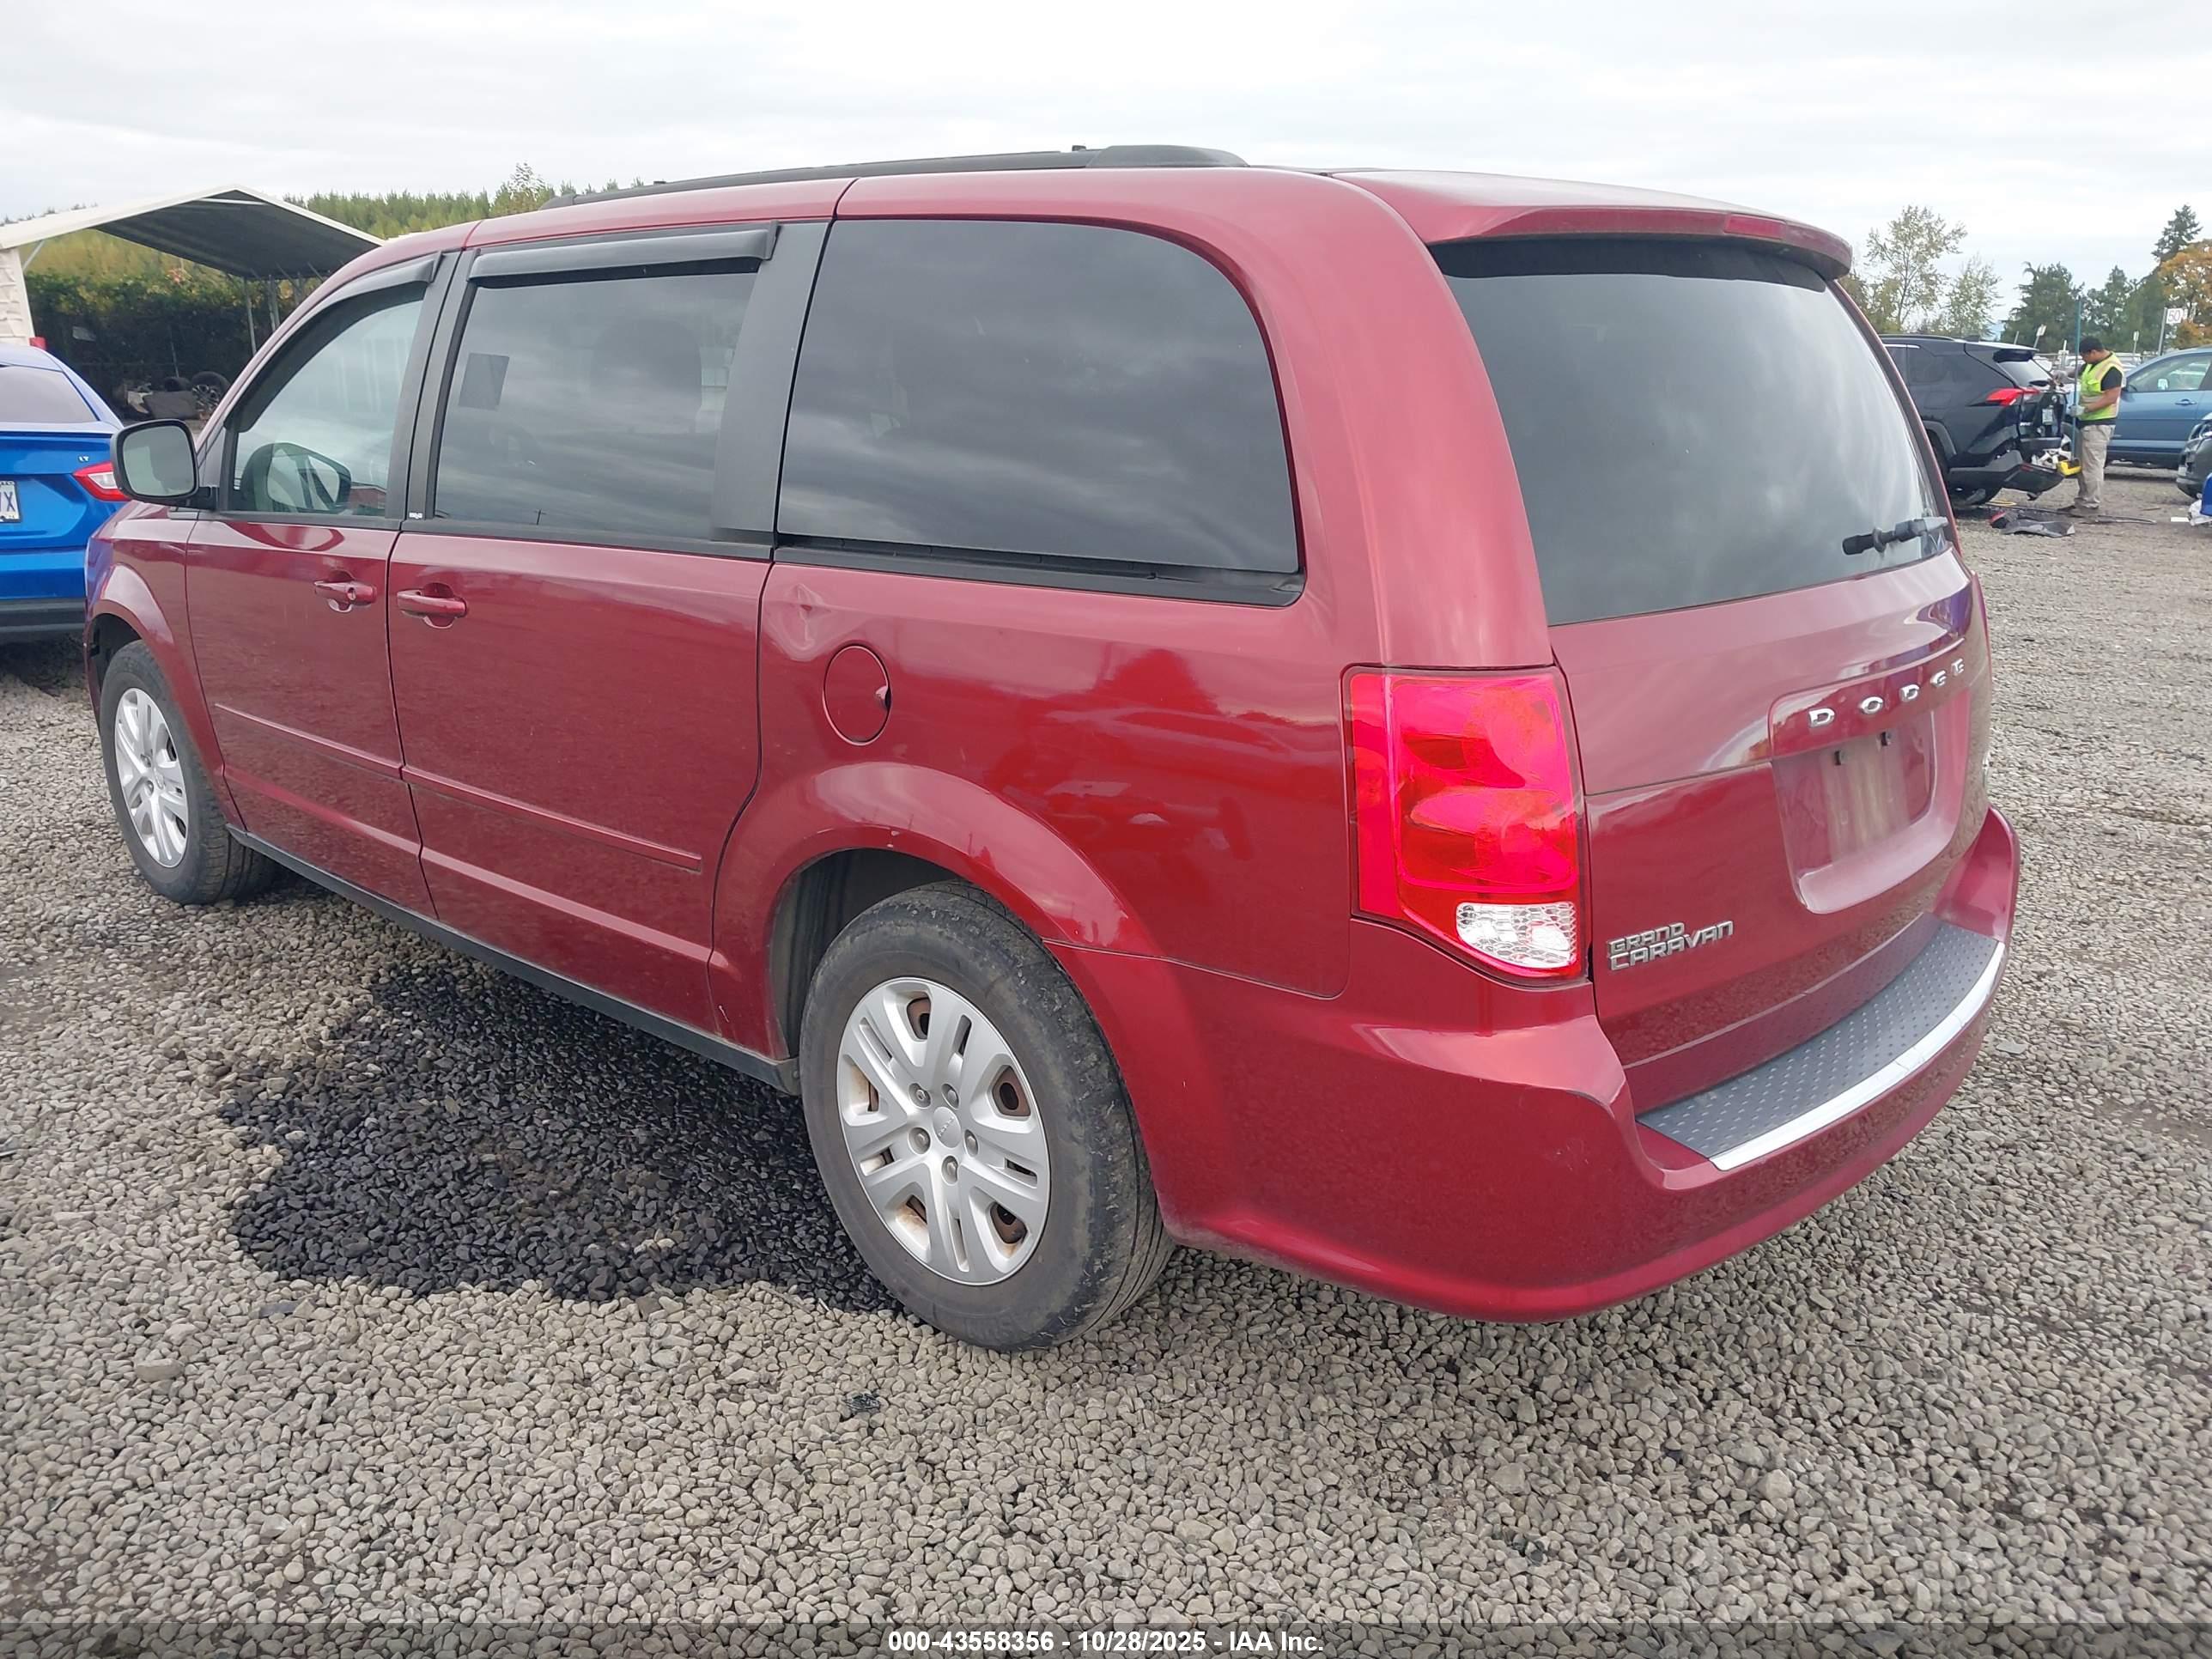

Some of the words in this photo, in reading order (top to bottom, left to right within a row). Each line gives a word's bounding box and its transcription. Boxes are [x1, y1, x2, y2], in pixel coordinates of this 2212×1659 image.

[2168, 310, 2181, 322] 50
[1808, 658, 1965, 727] DODGE
[1608, 922, 1685, 955] GRAND
[1610, 921, 1734, 970] CARAVAN
